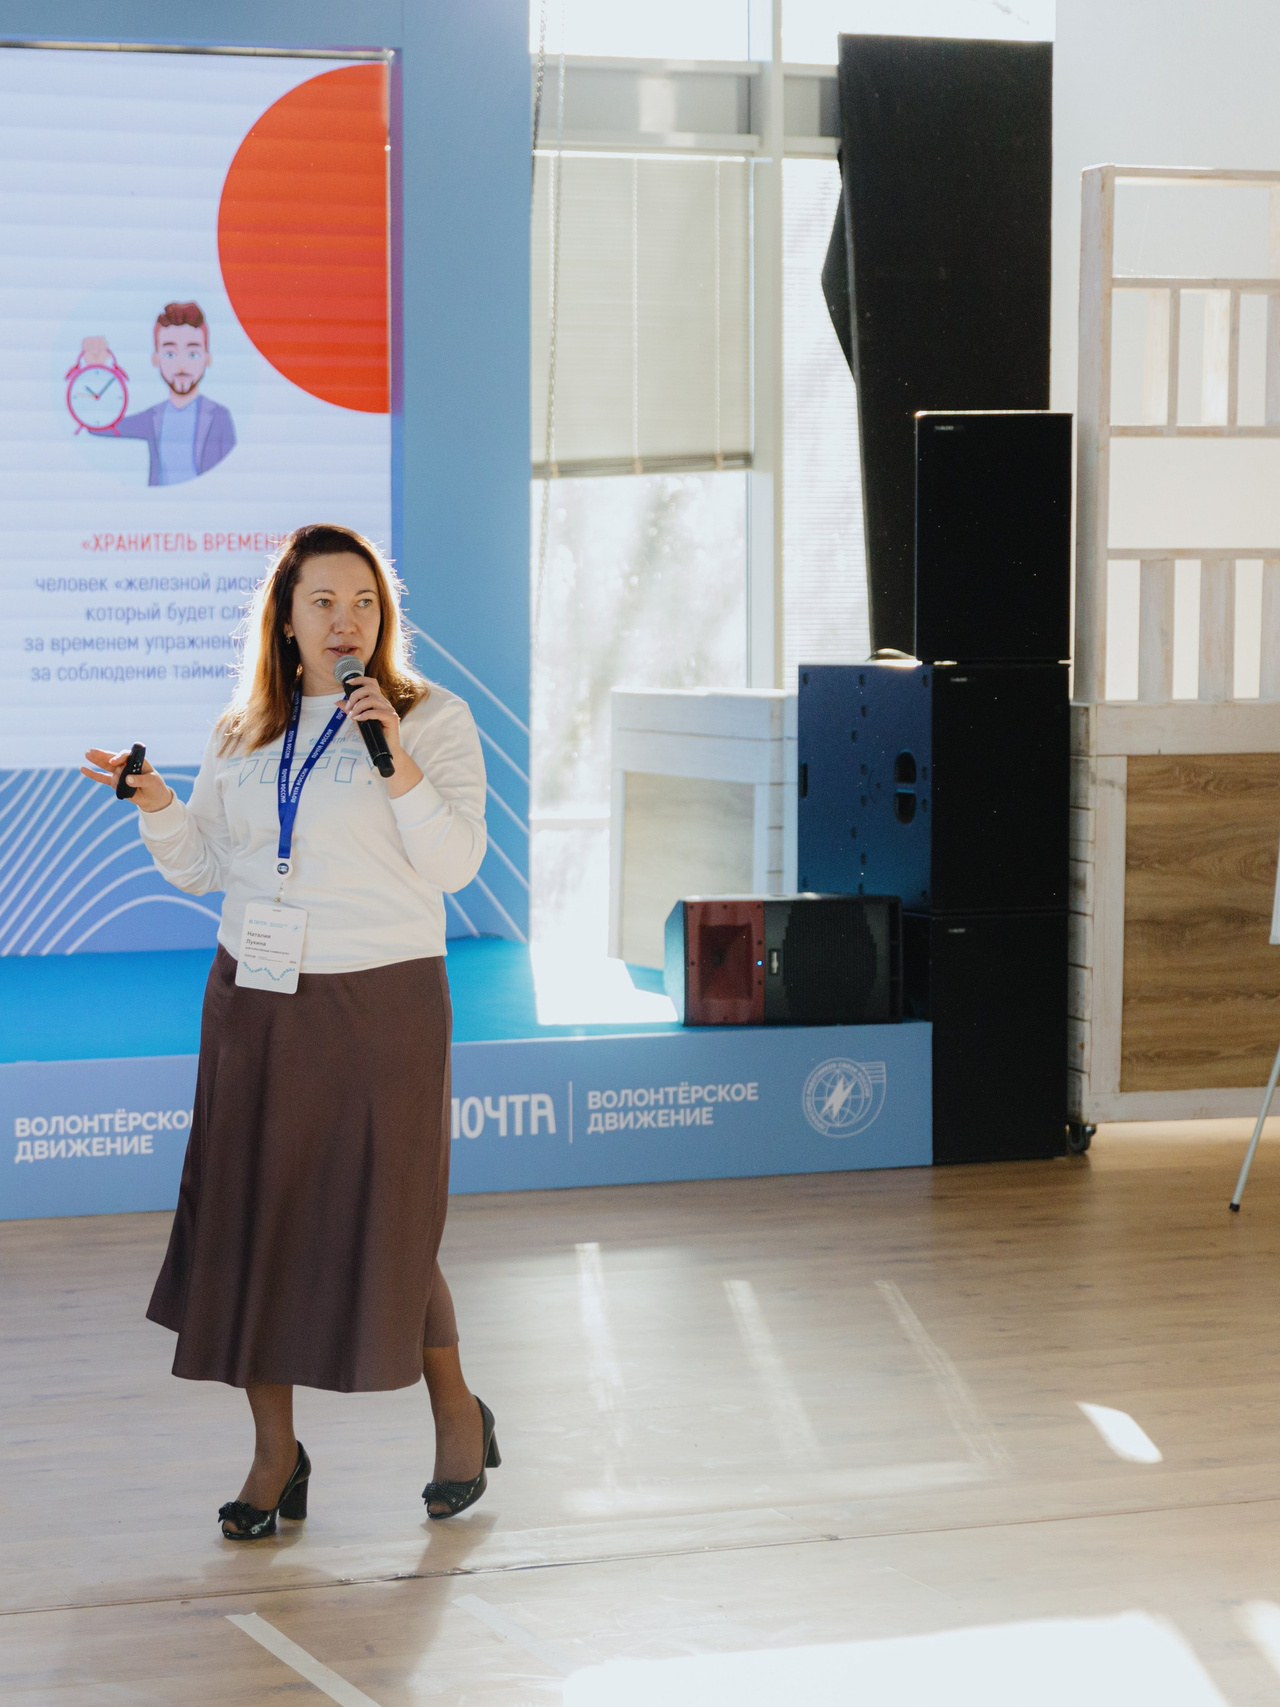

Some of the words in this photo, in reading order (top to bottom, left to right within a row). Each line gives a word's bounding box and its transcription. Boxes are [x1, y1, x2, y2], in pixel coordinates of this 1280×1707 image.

[81, 533, 198, 552] «ХРАНИТЕЛЬ
[35, 576, 108, 593] человек
[114, 572, 211, 593] «железной
[85, 602, 161, 625] который
[166, 602, 215, 625] будет
[23, 637, 45, 652] за
[51, 634, 139, 656] временем
[30, 665, 52, 682] за
[57, 662, 167, 682] соблюдение
[587, 1080, 759, 1111] ВОЛОНТЁРСКОЕ
[14, 1107, 194, 1138] ВОЛОНТЁРСКО
[587, 1106, 714, 1135] ДВИЖЕНИЕ
[14, 1133, 155, 1164] ДВИЖЕНИЕ
